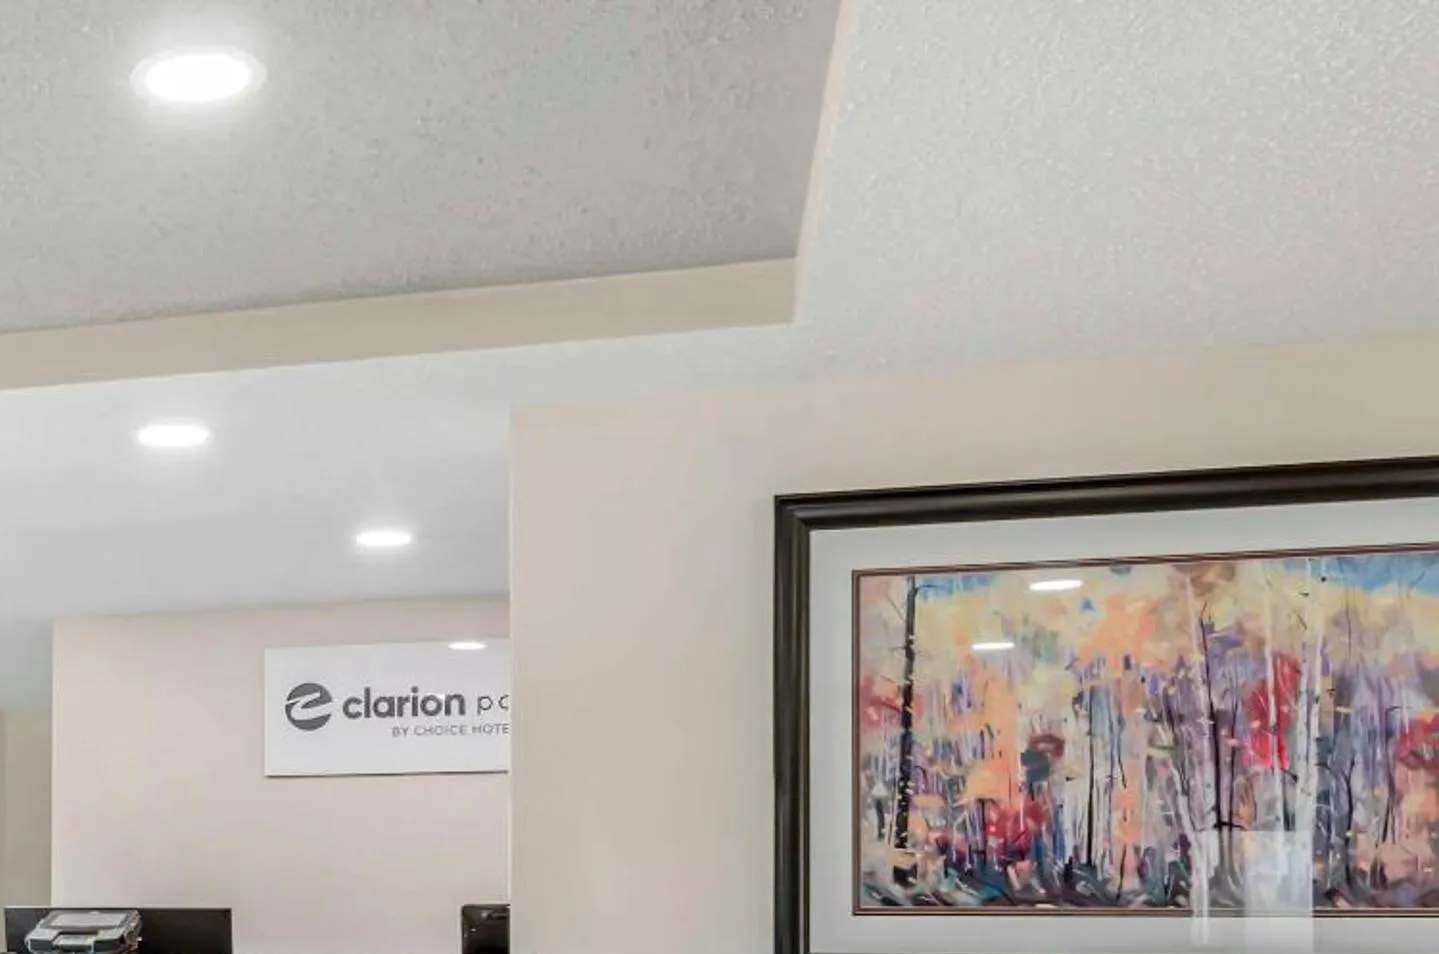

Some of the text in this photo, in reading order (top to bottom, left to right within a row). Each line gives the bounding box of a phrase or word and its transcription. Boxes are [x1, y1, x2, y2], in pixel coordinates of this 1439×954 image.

[343, 686, 466, 719] clarion
[391, 726, 409, 738] BY
[414, 724, 468, 736] CHOICE
